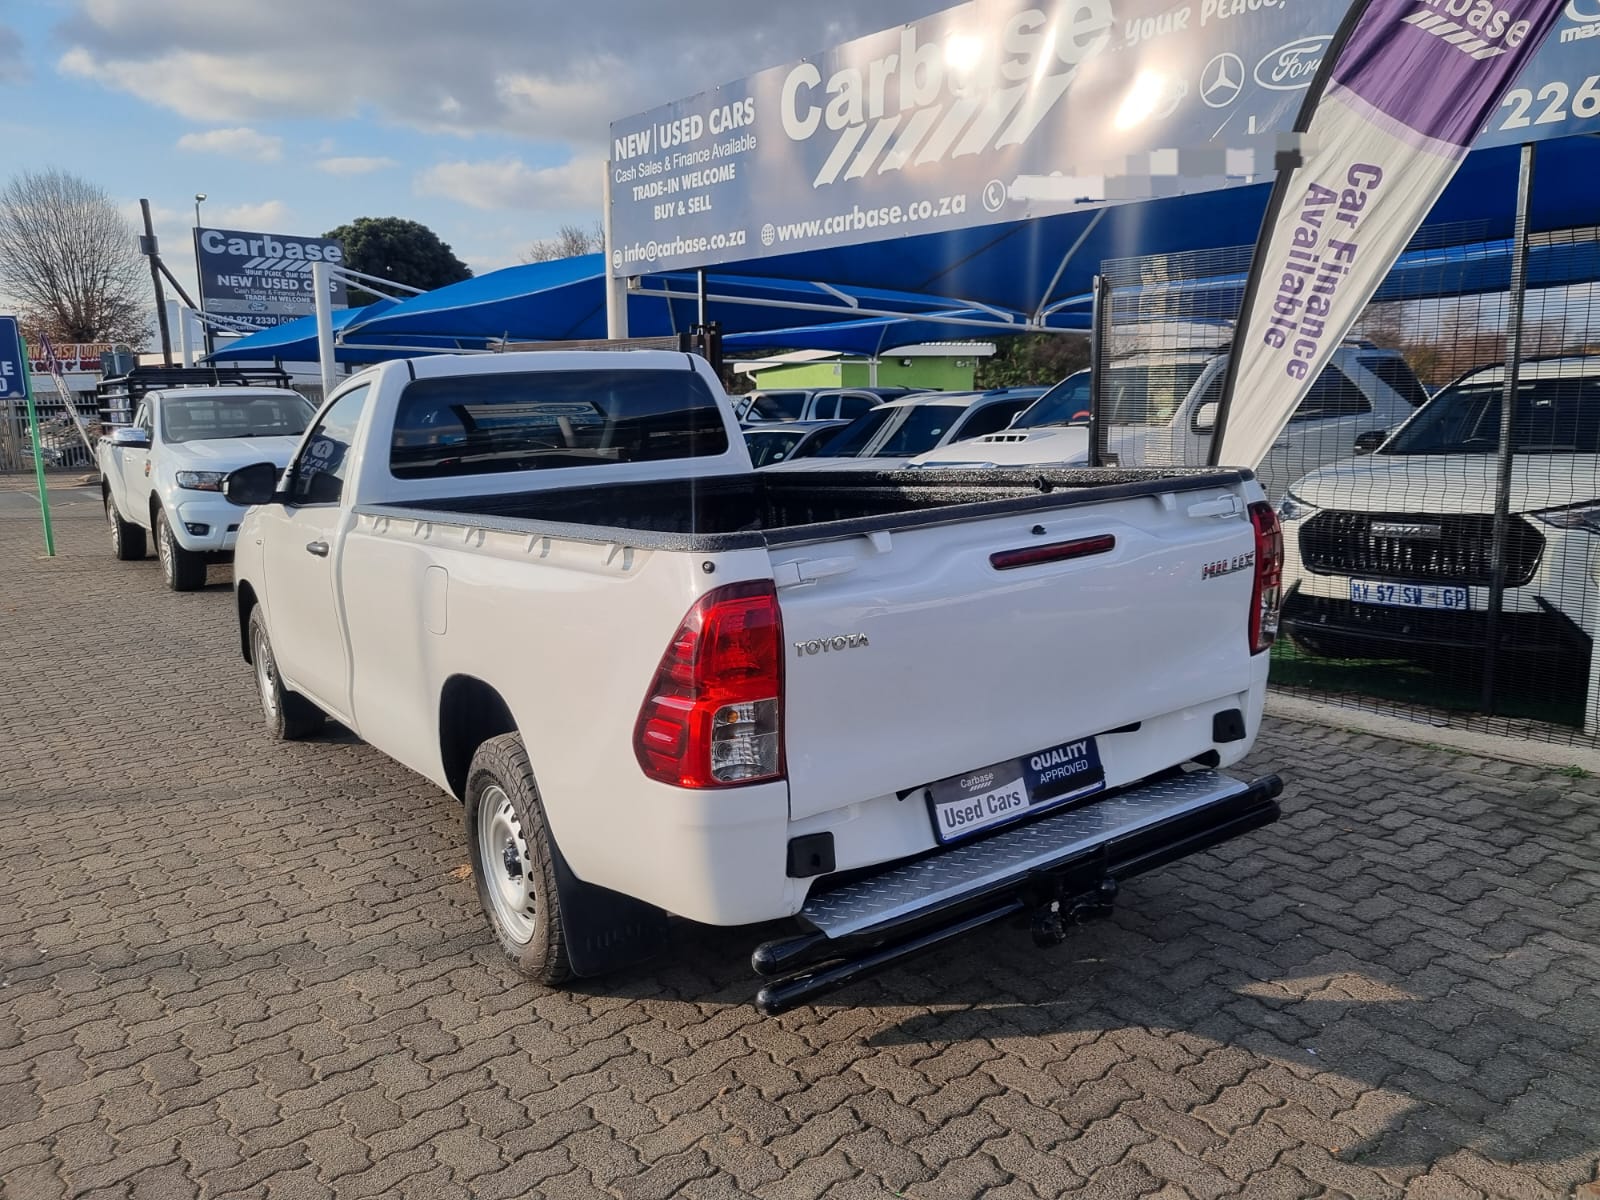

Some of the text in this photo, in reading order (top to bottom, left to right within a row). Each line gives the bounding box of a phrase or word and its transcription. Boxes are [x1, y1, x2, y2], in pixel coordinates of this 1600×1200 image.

[1416, 0, 1531, 48] base
[780, 0, 1114, 141] Carbse
[615, 97, 755, 161] NEW USED CARS
[615, 133, 756, 184] Cash Sales & Finance Available
[633, 163, 736, 202] TRADE-IN WELCOME
[654, 194, 712, 220] BUY & SELL
[777, 193, 966, 242] www.carbase.co.za
[200, 230, 342, 262] Carbase
[624, 229, 746, 263] info@carbase.co.za
[1263, 182, 1338, 349] Available
[217, 274, 338, 293] NEW USED CS
[1286, 163, 1383, 381] Car Finance
[793, 632, 869, 657] TOYOTA
[1030, 740, 1088, 771] QUALITY
[1039, 759, 1088, 784] APPROVED
[960, 771, 994, 789] Carbase
[944, 790, 1021, 829] Used Cars
